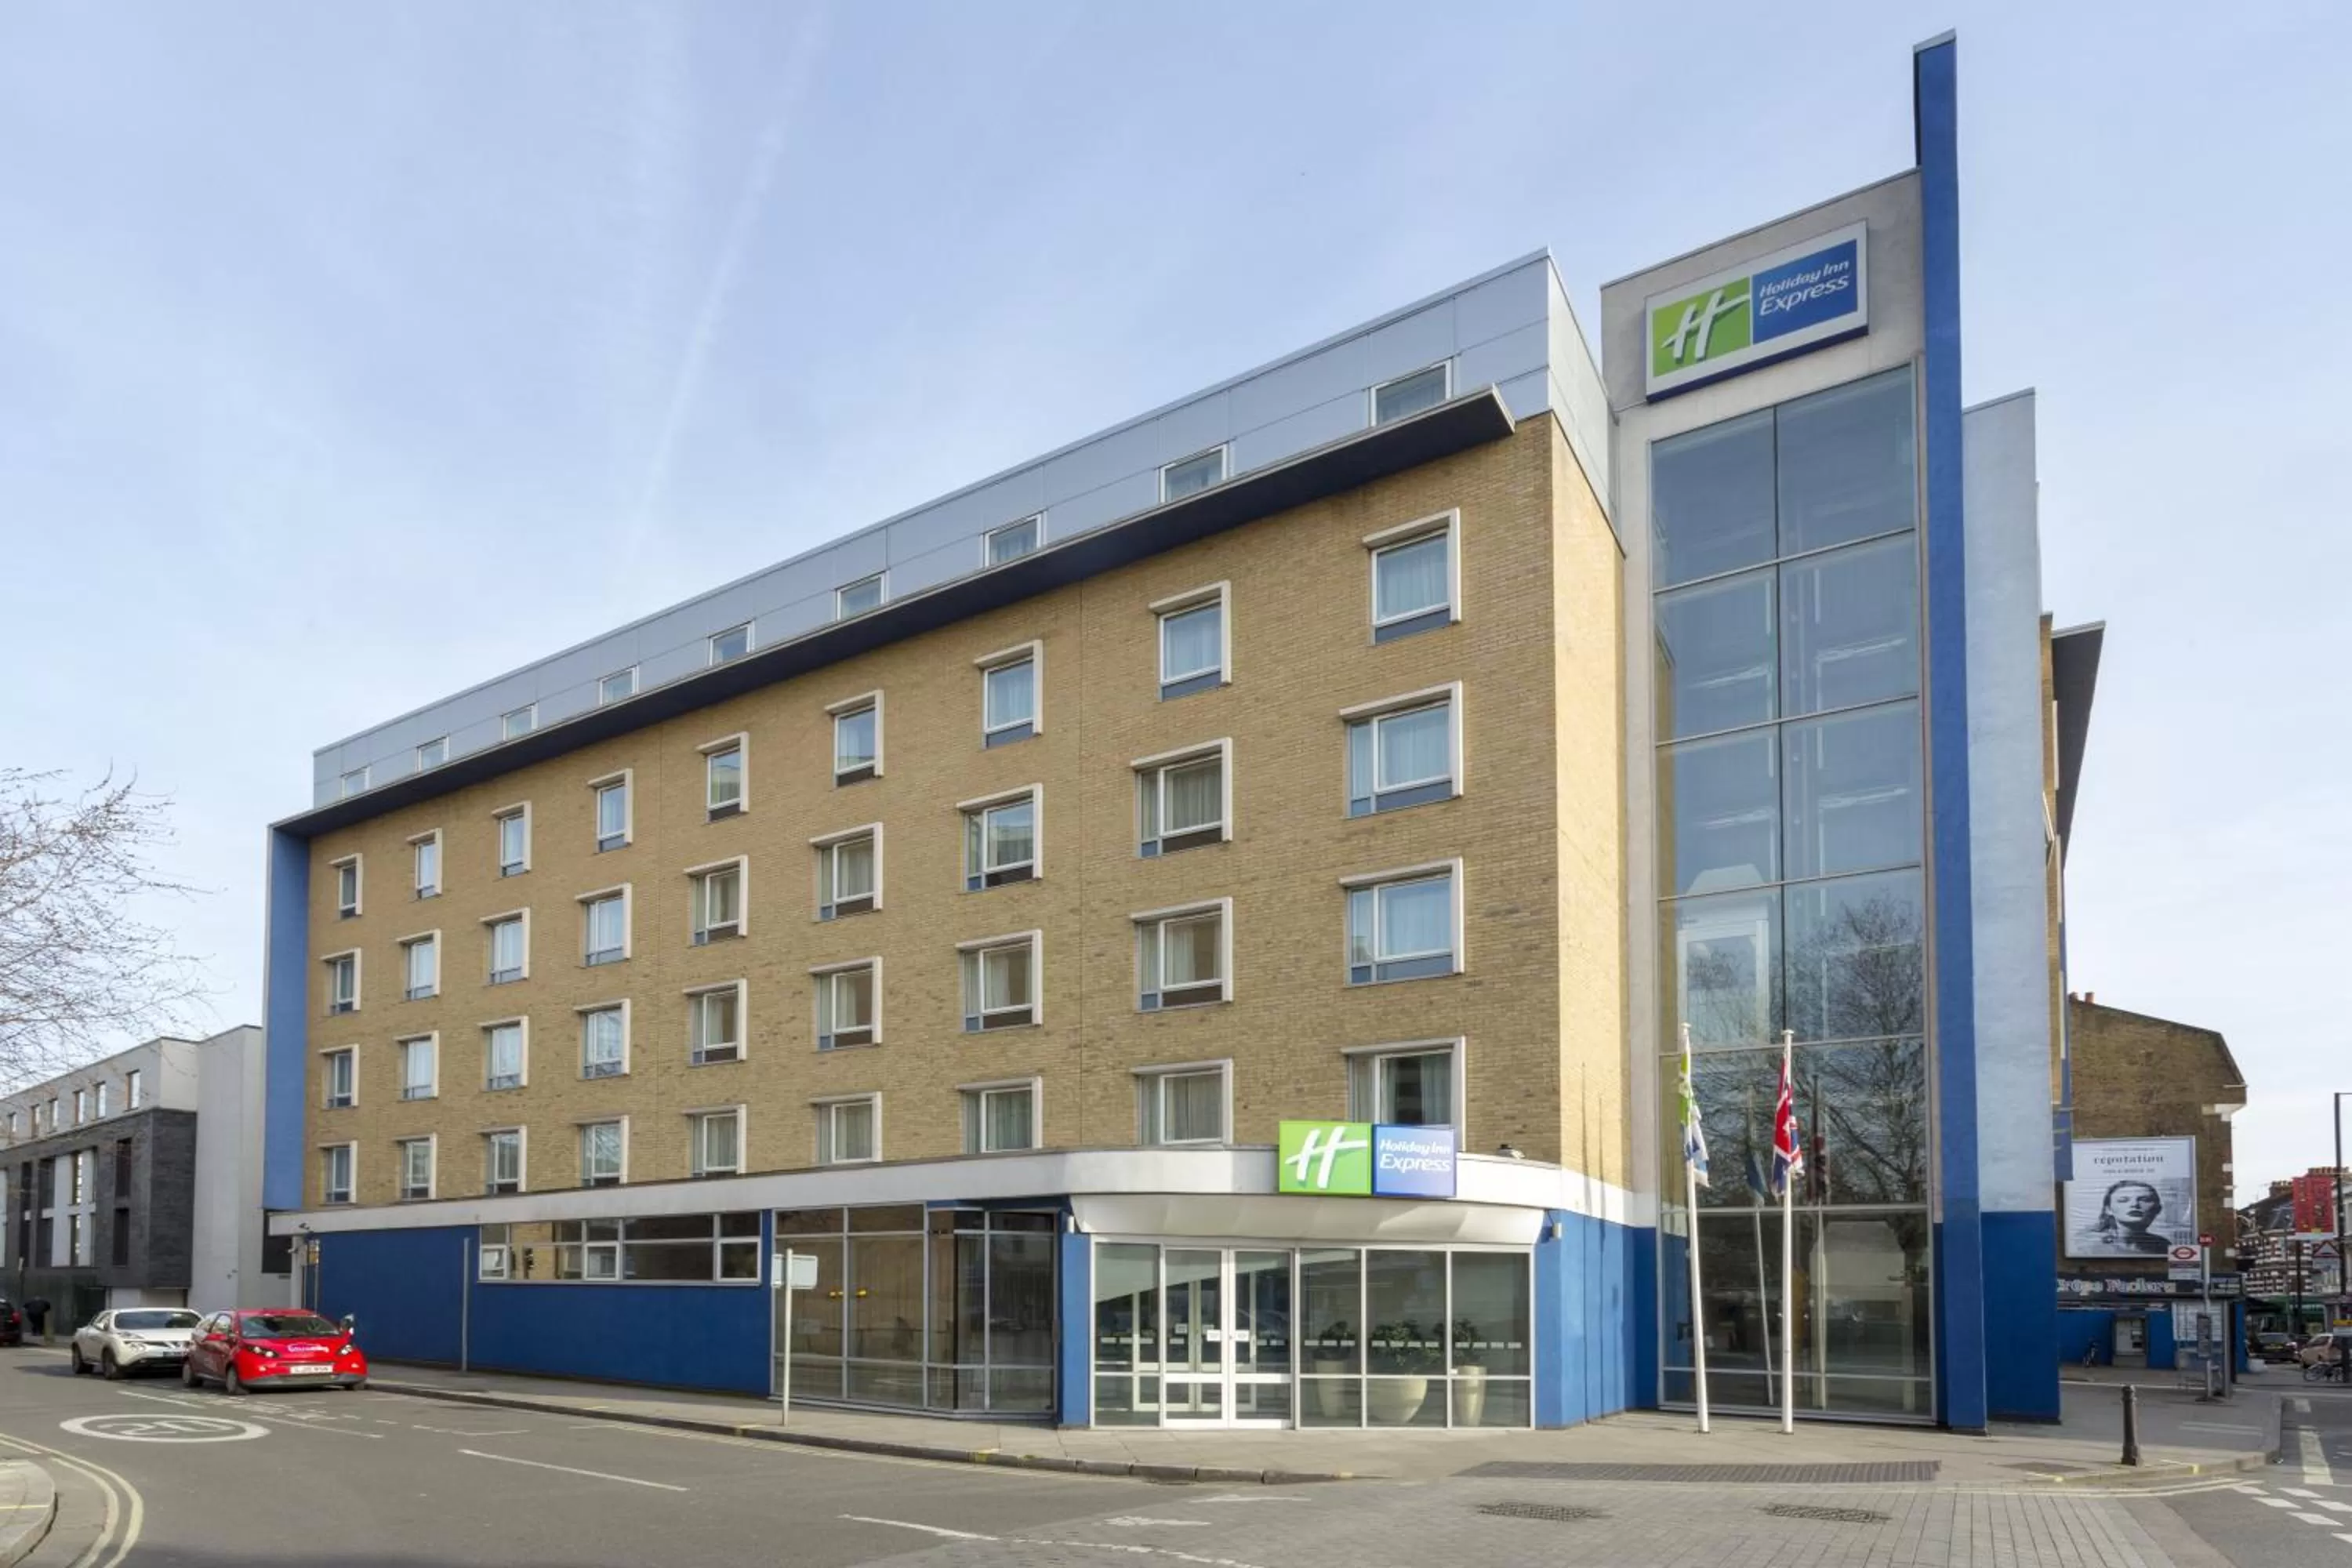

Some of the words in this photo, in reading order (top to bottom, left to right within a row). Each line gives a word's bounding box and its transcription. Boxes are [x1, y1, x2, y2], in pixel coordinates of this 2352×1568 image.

[1760, 269, 1820, 297] Holiday
[1824, 260, 1849, 277] Inn
[1760, 275, 1849, 316] Express
[1380, 1139, 1430, 1155] Holiday
[1431, 1143, 1450, 1155] Inn
[1380, 1153, 1450, 1173] Express
[2094, 1154, 2163, 1165] reputation
[100, 1419, 234, 1436] 20
